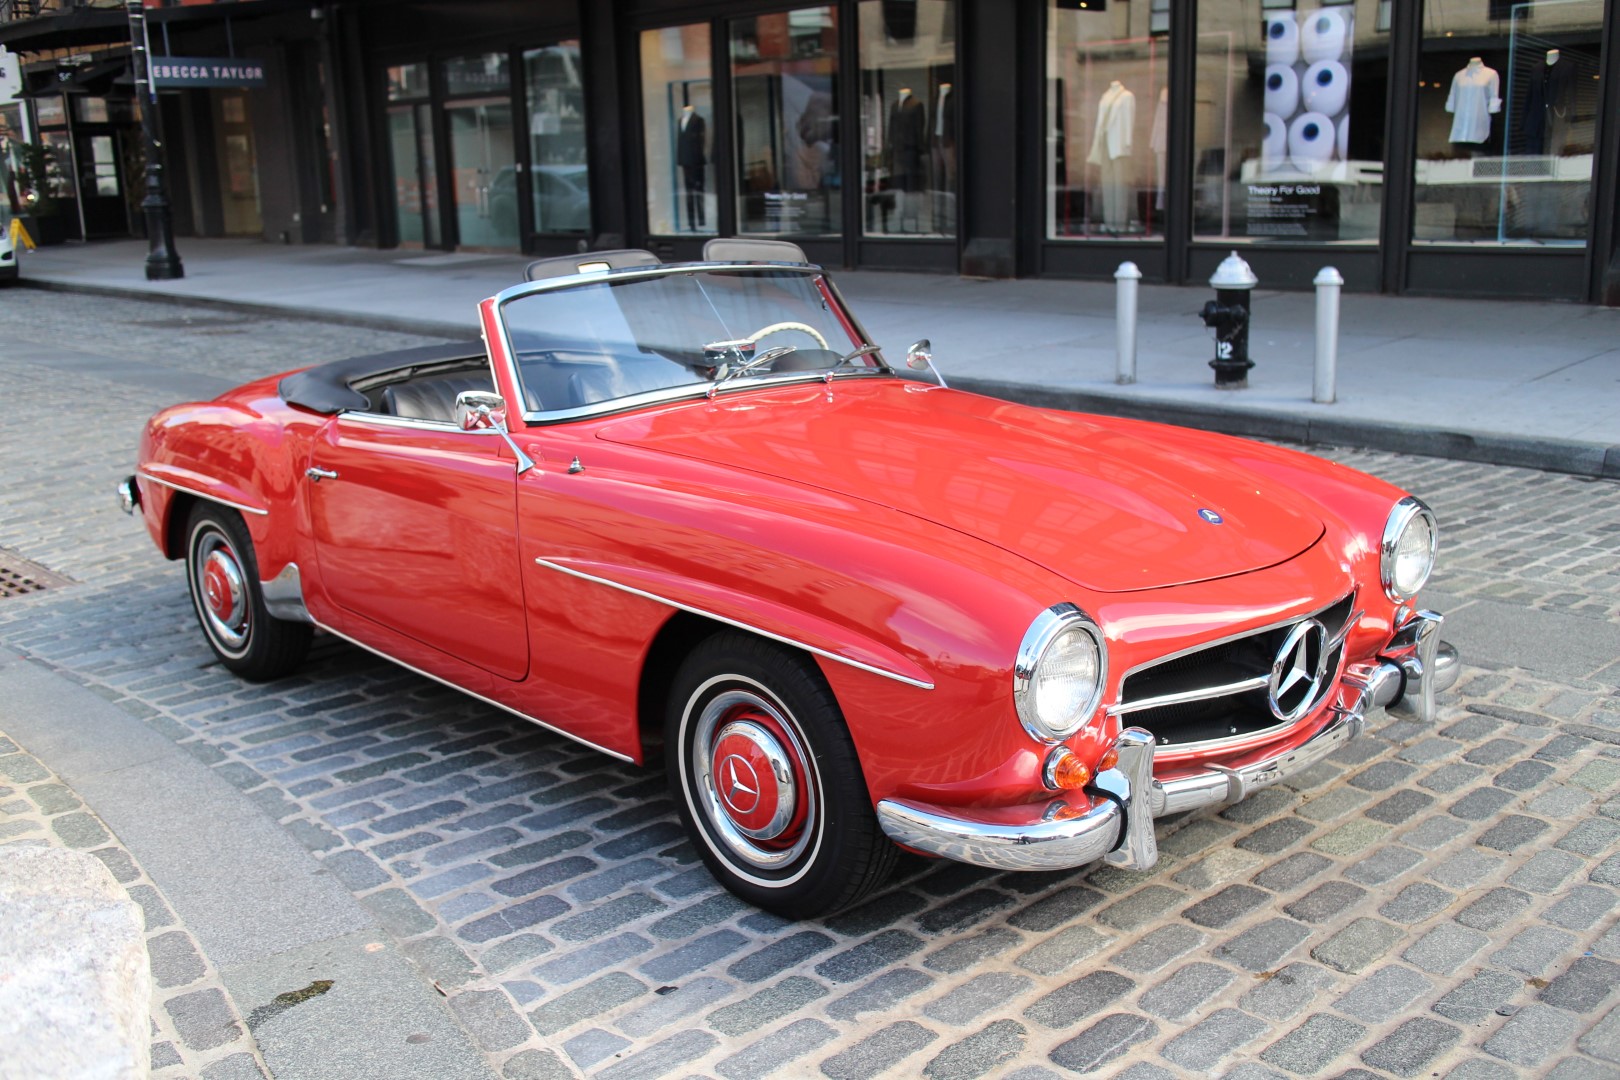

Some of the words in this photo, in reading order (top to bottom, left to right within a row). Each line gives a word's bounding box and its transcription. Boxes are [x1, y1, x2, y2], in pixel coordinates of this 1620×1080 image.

[153, 65, 209, 78] EBECCA
[212, 66, 263, 79] TAYLOR
[1248, 185, 1278, 196] Theory
[1279, 185, 1294, 195] For
[1296, 185, 1320, 195] Good
[1218, 342, 1233, 359] 12
